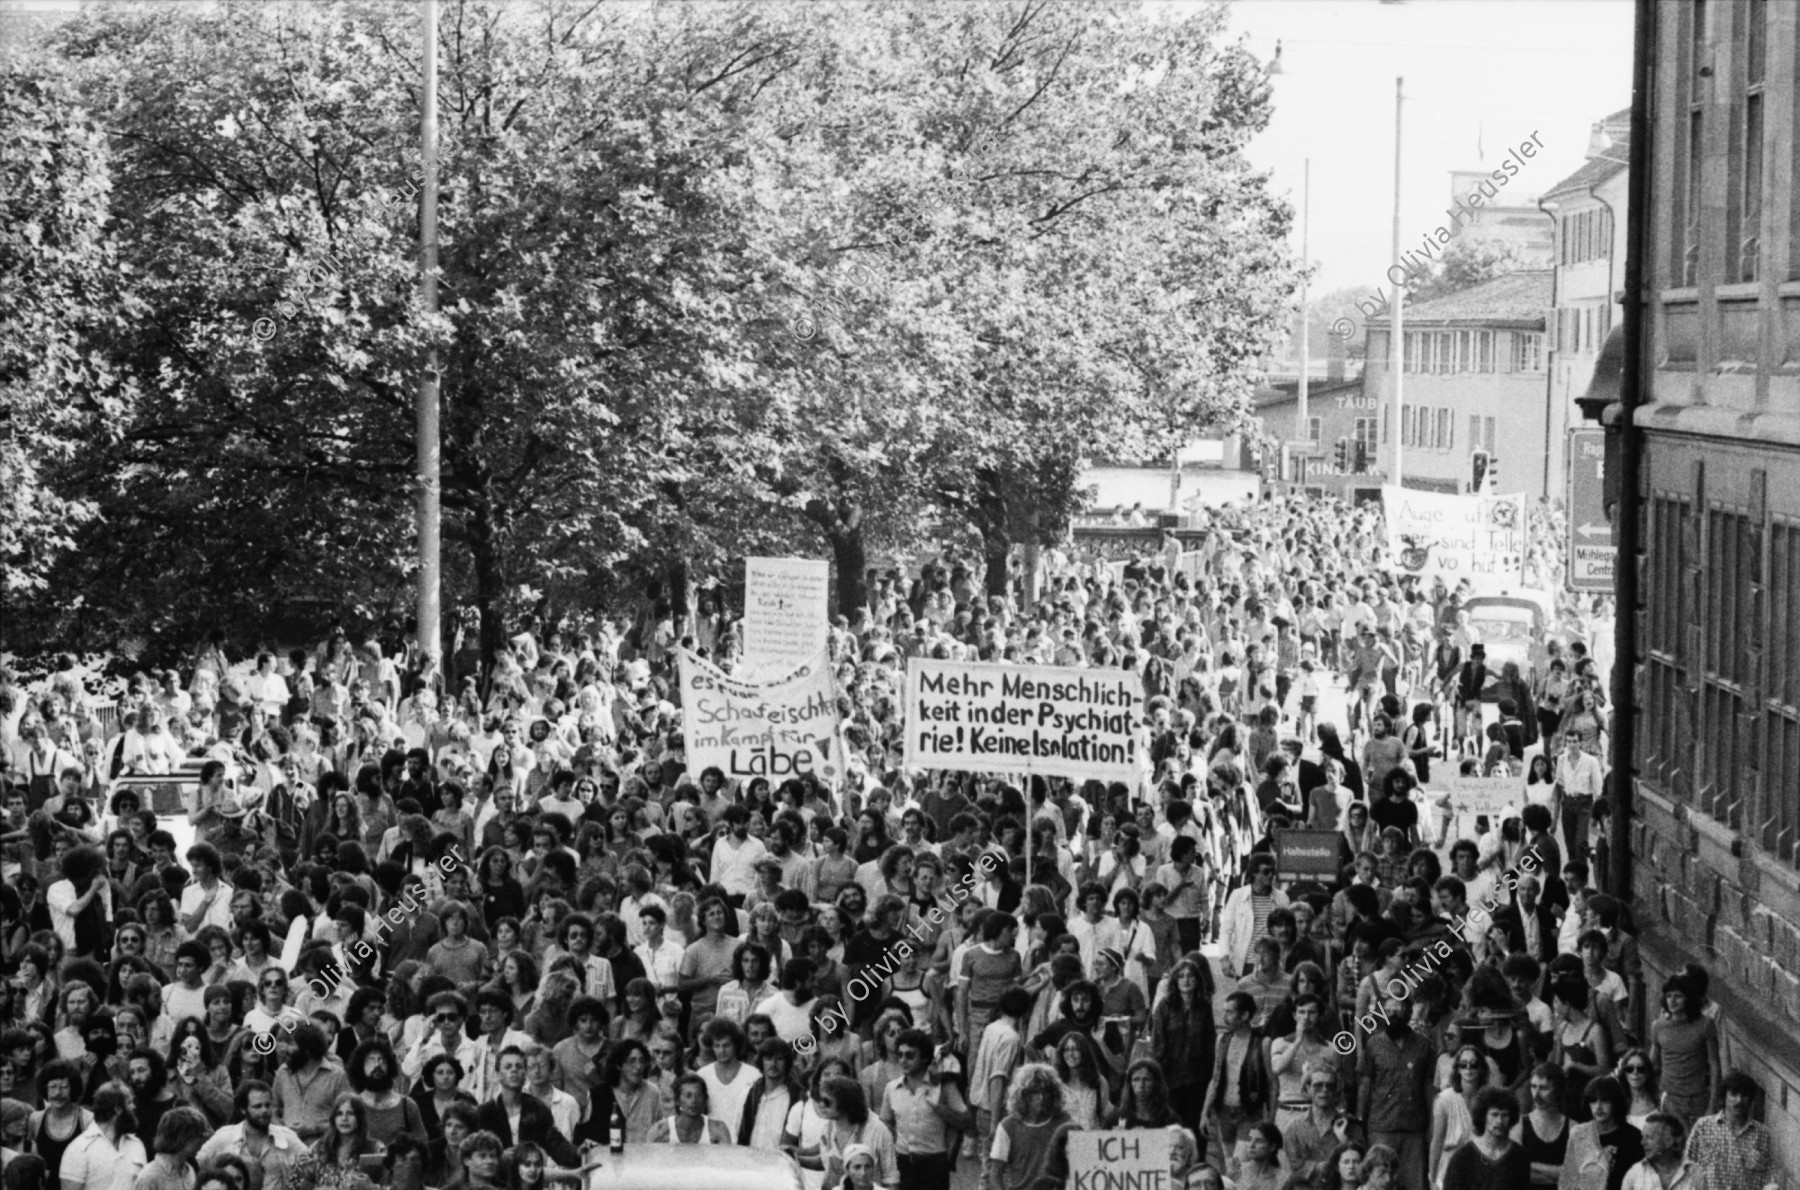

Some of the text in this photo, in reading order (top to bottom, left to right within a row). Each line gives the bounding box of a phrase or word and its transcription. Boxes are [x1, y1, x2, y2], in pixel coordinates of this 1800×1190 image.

[1399, 500, 1444, 529] Auge
[1438, 556, 1459, 571] vo
[920, 670, 1142, 708] Mehr Menschlich-
[919, 699, 961, 722] keit
[1037, 702, 1141, 736] Psychiat-
[920, 725, 964, 754] rie!
[1097, 1136, 1141, 1162] ICH
[1074, 1165, 1168, 1190] KÖNNTE
